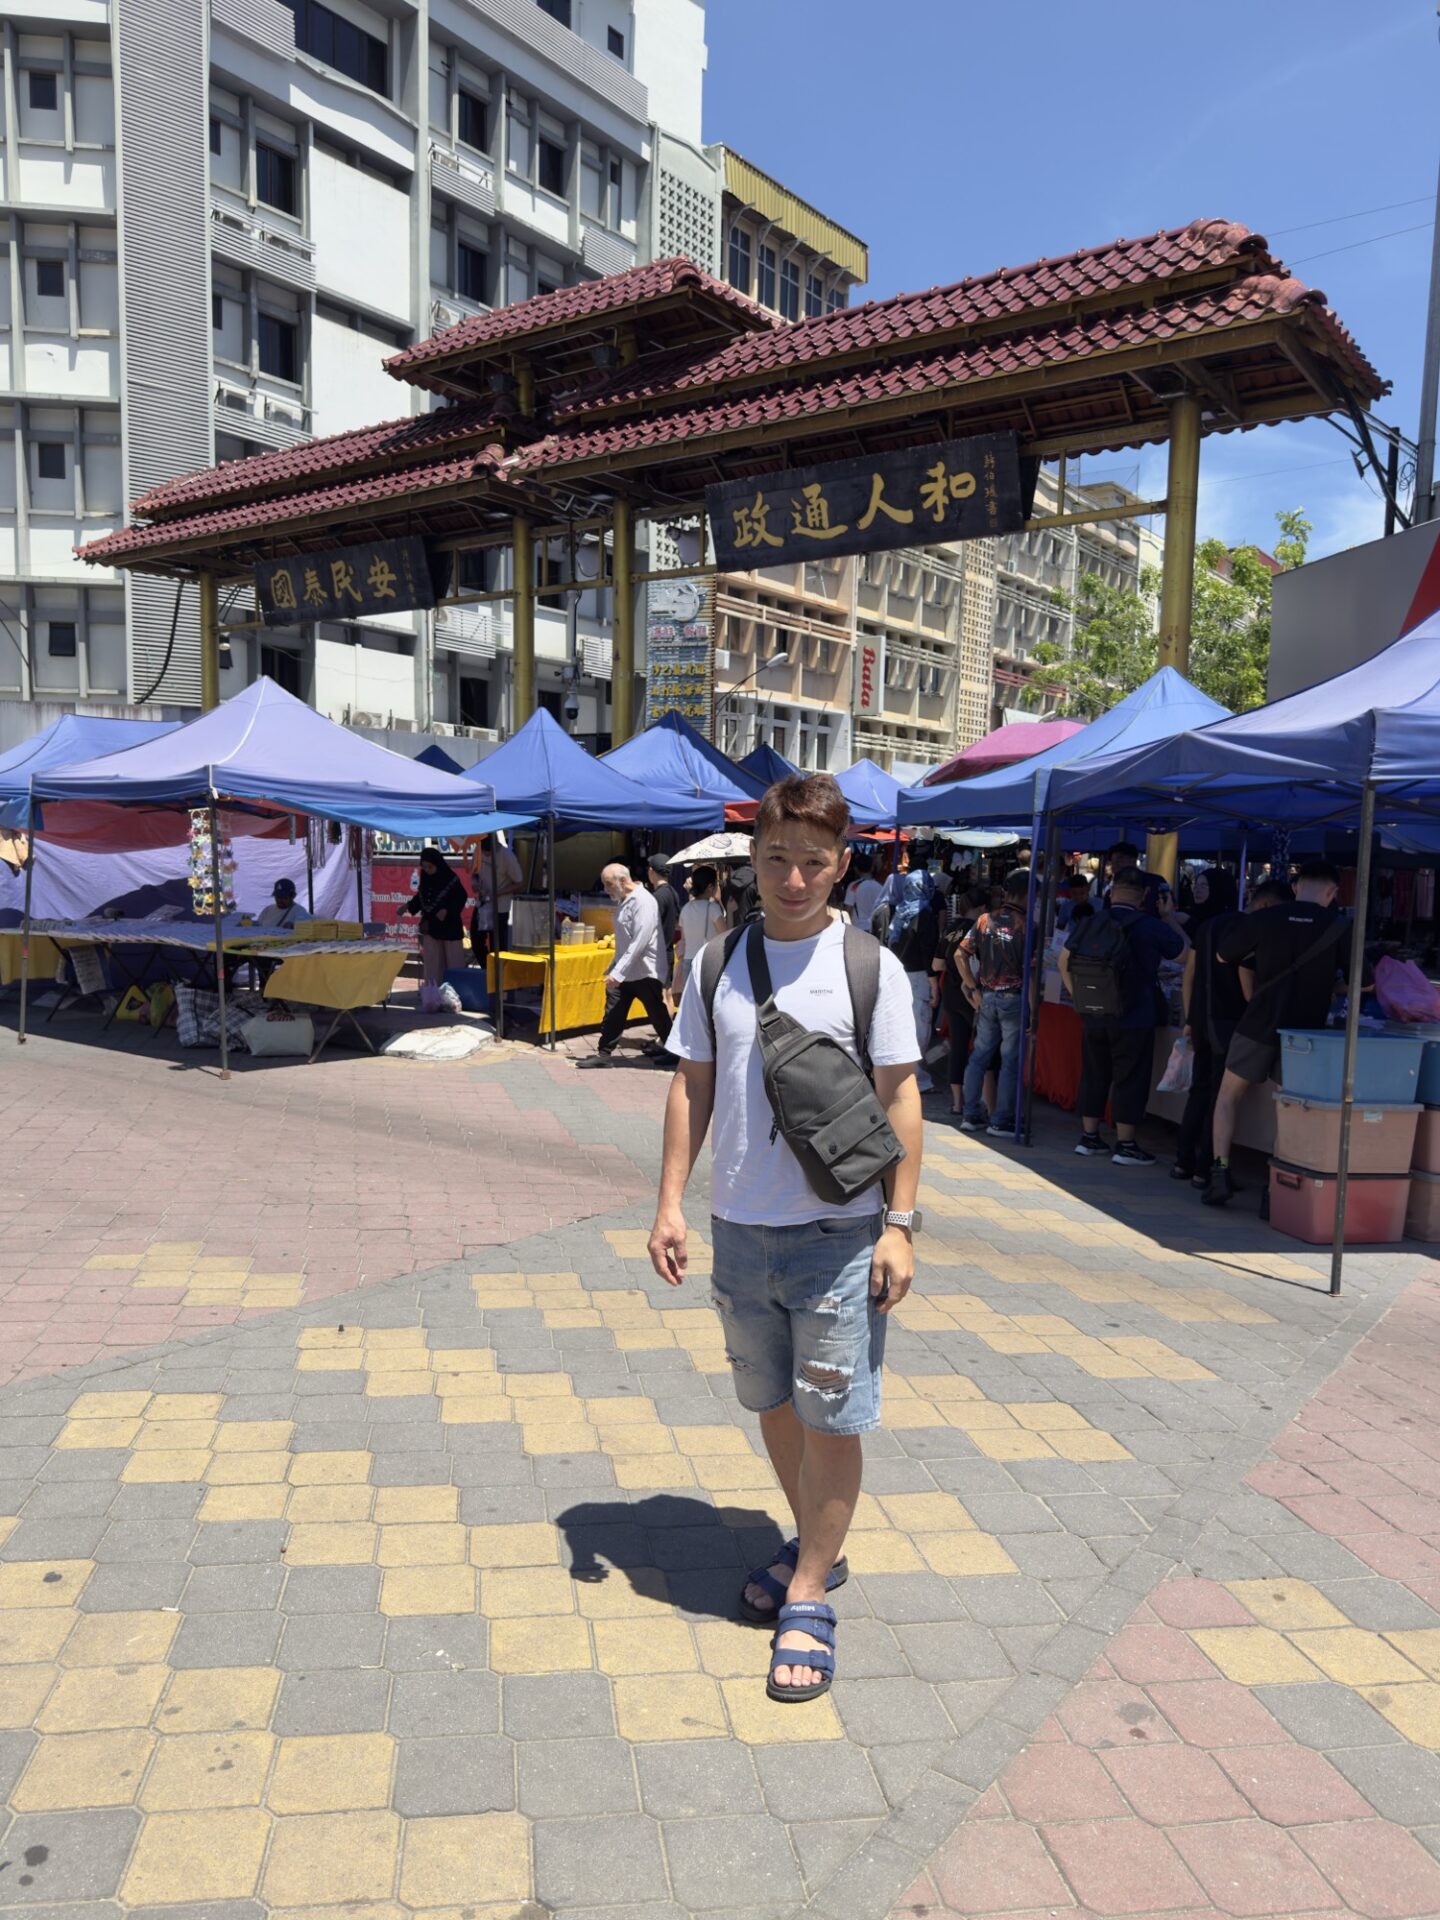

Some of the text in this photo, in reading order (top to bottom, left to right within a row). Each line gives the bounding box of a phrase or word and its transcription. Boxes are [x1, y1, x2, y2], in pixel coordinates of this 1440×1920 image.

[732, 461, 977, 548] 政通人和
[270, 554, 398, 609] 國泰民安
[861, 645, 876, 709] Bata
